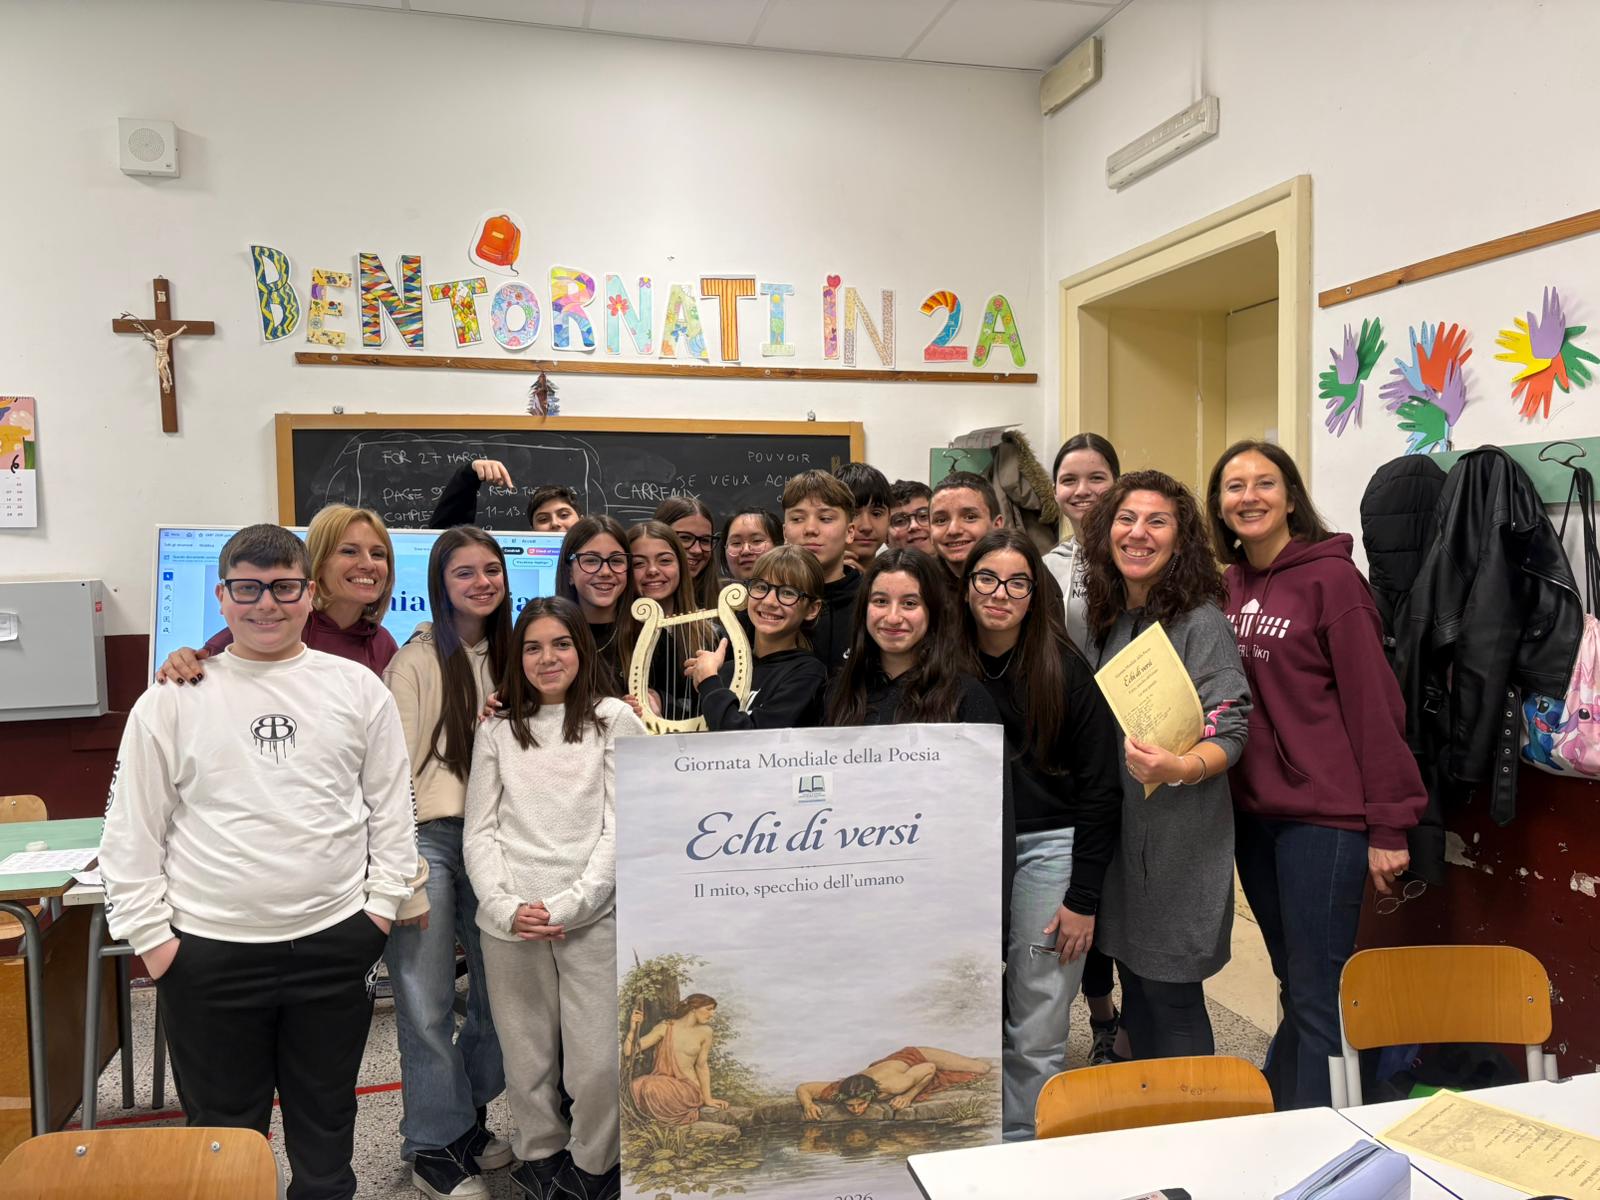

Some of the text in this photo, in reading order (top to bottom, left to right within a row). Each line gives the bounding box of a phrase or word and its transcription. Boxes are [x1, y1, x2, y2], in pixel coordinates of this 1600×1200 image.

[250, 244, 1027, 369] BENTORNATI IN 2A
[382, 450, 412, 465] FOR
[418, 452, 442, 464] 27
[383, 487, 424, 506] PAGE
[674, 747, 940, 773] Giornata Mondiale della Poesia
[686, 808, 923, 860] Echi di versi
[694, 873, 904, 899] Il mito, specchio dell'umano
